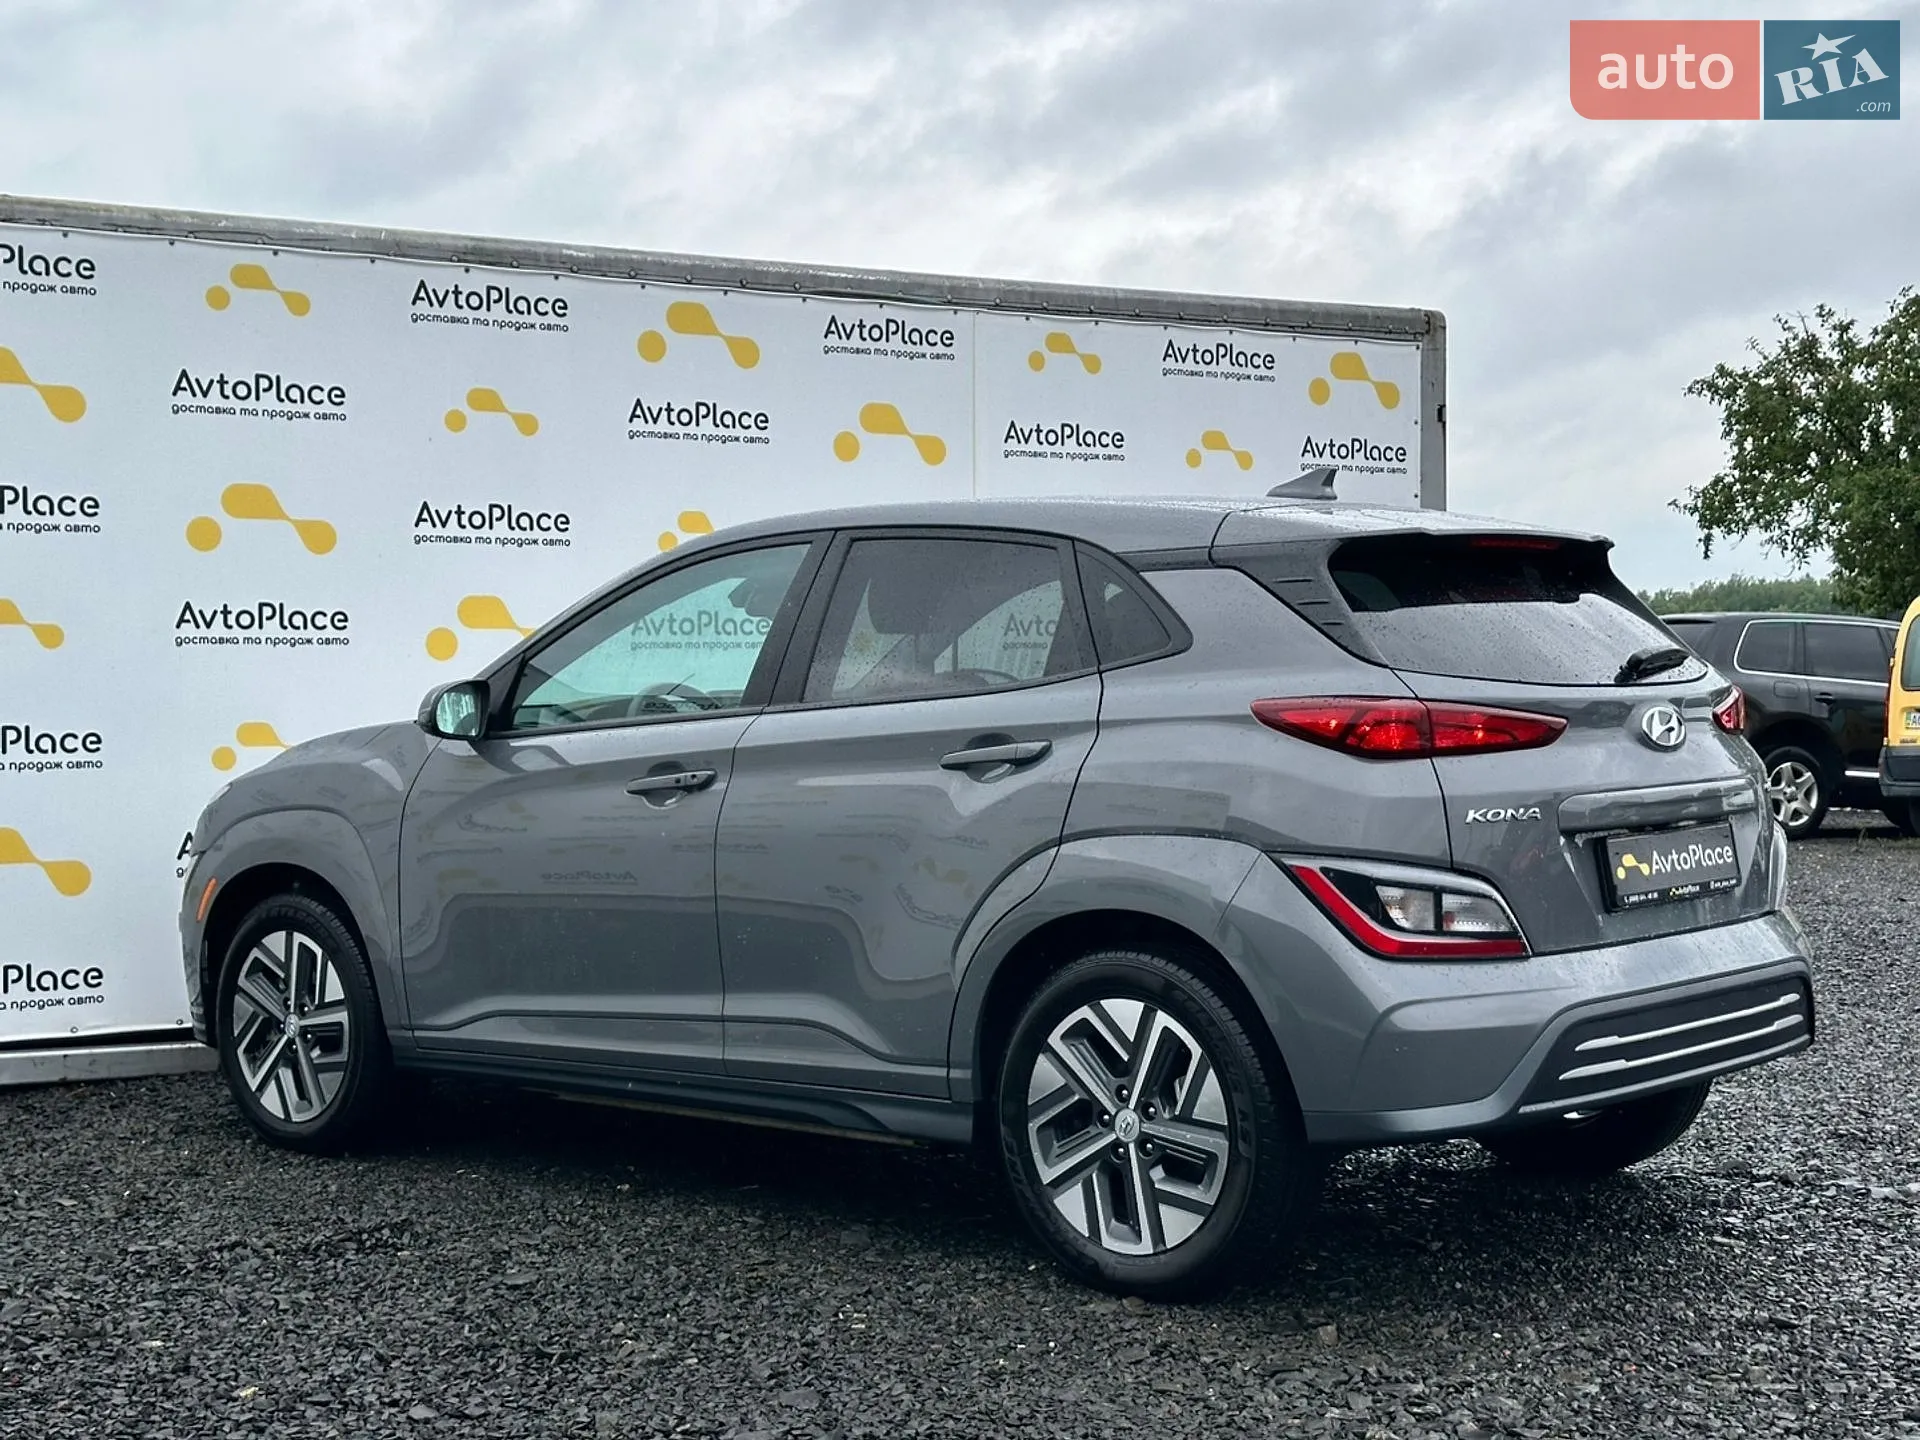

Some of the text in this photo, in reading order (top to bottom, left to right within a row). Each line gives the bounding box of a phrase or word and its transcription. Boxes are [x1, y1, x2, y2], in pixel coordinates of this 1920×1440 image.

[411, 279, 569, 318] AvtoPlace
[823, 315, 955, 348] AvtoPlace
[1163, 339, 1275, 371] AvtoPlace
[172, 369, 346, 406] AvtoPlace
[628, 398, 769, 431] AvtoPlace
[1004, 419, 1125, 450] AvtoPlace
[1300, 435, 1407, 463] AvtoPlace
[0, 485, 100, 518] Place
[414, 501, 571, 533] AvtoPlace
[175, 601, 349, 631] AvtoPlace
[631, 610, 771, 637] AvtoPlace
[1, 725, 103, 756] Place
[1465, 807, 1542, 824] KONA
[1652, 843, 1733, 876] AvtoPlace
[3, 963, 104, 995] Place
